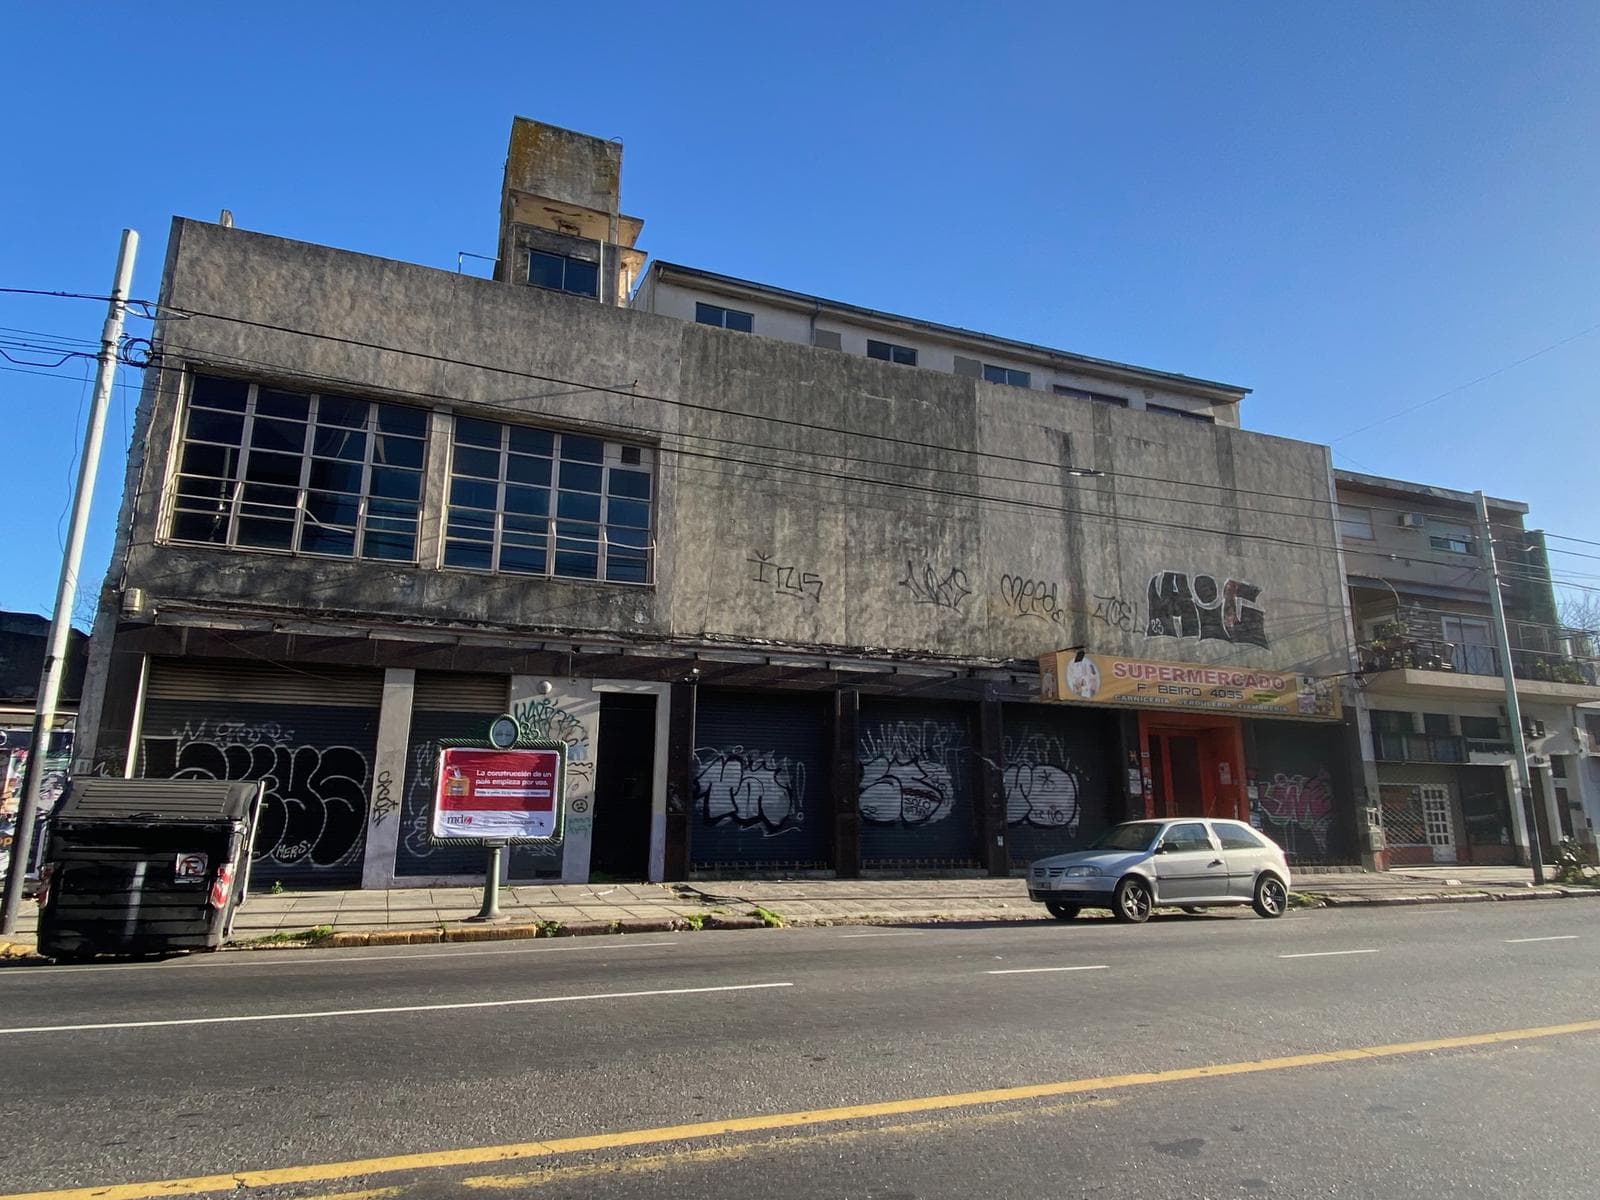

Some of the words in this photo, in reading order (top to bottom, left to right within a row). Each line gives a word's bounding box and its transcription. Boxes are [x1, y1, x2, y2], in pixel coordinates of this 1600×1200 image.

[1113, 662, 1286, 690] SUPERMERCADO
[1158, 685, 1202, 697] BEIRO
[476, 769, 486, 777] La
[487, 769, 531, 777] construcción
[492, 778, 521, 787] empieza
[521, 779, 534, 787] por
